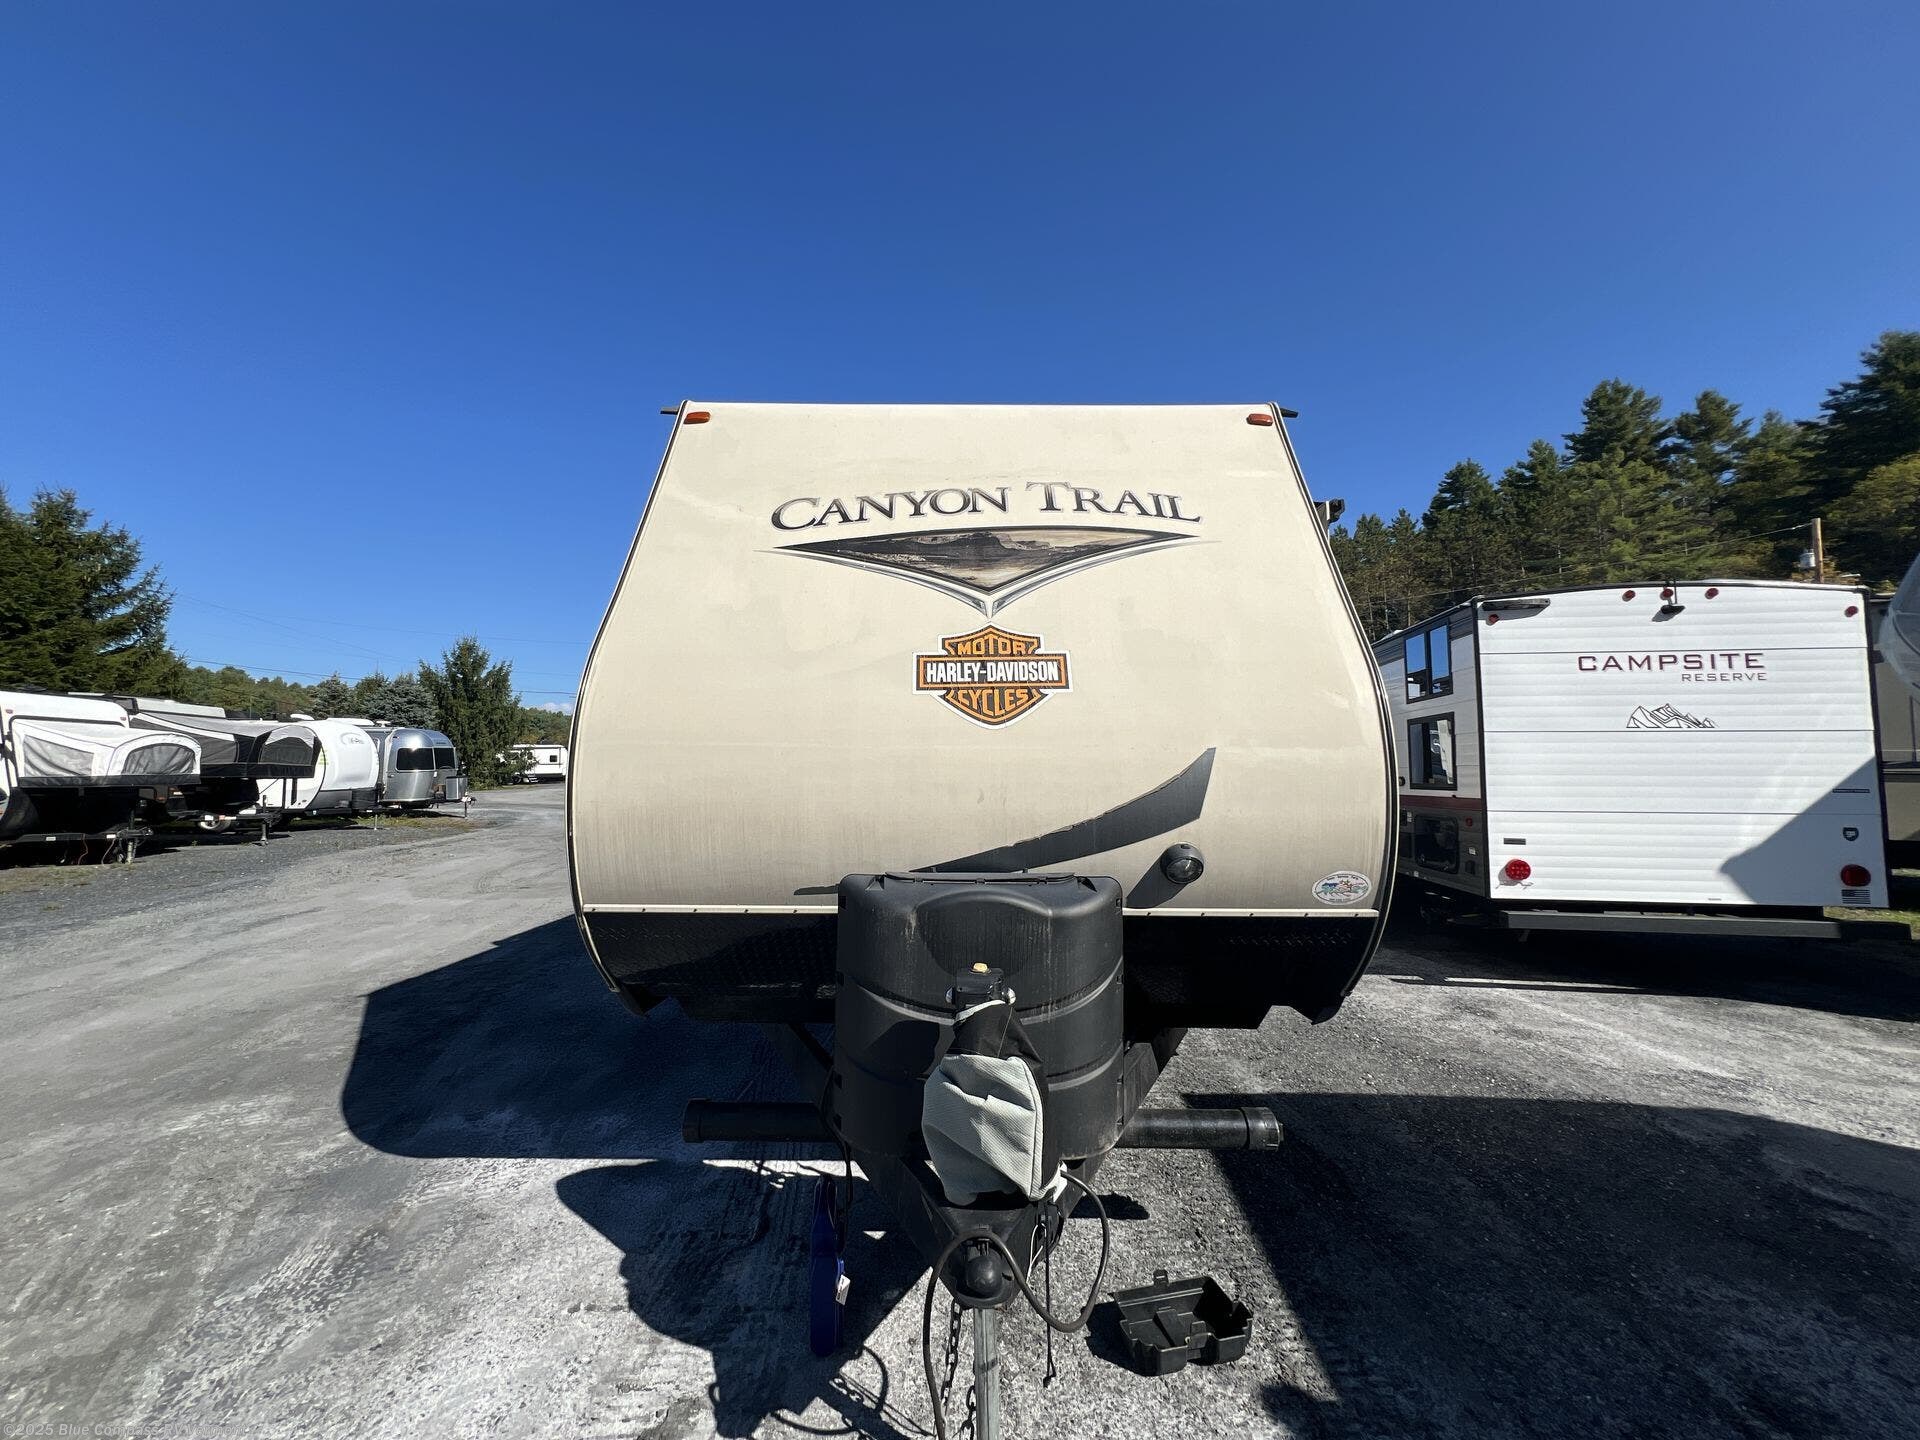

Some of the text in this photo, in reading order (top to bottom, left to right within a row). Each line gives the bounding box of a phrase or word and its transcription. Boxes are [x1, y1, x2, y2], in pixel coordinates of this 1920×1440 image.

[771, 481, 1203, 531] CANYON TRAIL
[957, 633, 1027, 655] MOTOR
[926, 661, 1060, 683] HARLEY-DAVIDSON
[1578, 652, 1766, 671] CAMPSITE
[1681, 672, 1768, 682] RESERVE
[957, 688, 1029, 716] CYCLES
